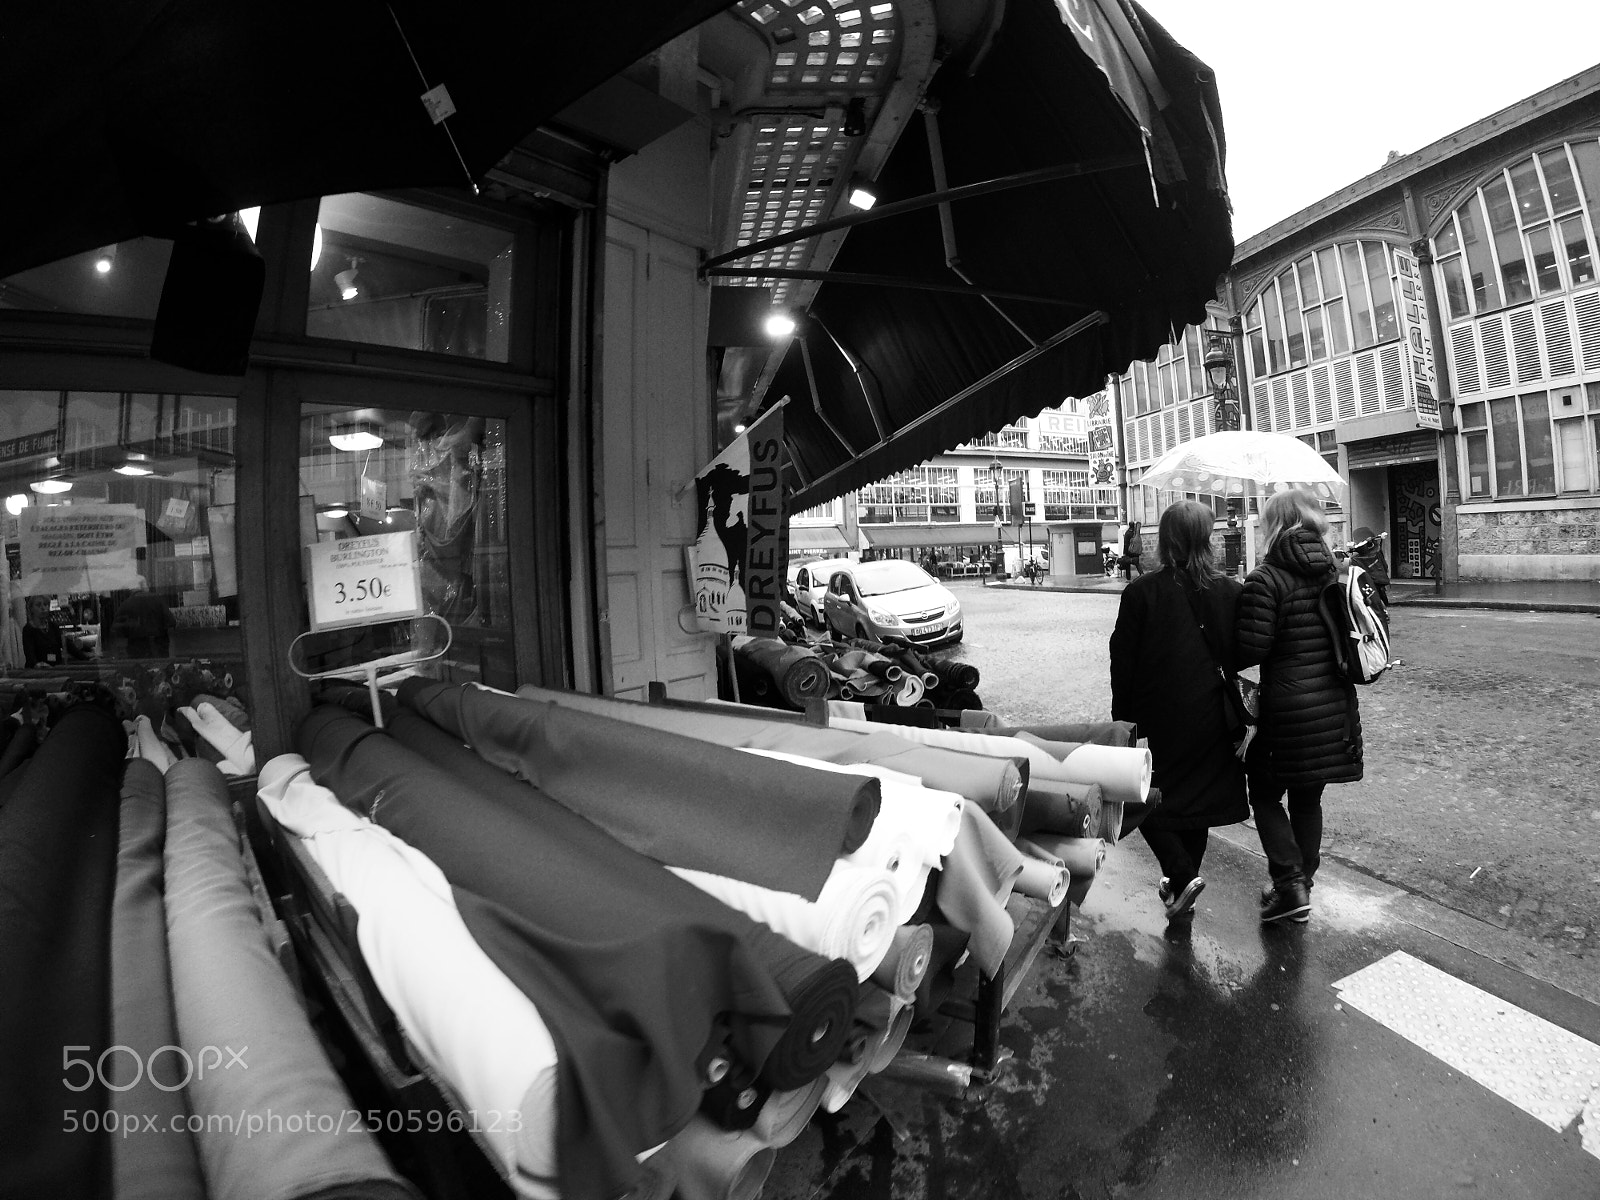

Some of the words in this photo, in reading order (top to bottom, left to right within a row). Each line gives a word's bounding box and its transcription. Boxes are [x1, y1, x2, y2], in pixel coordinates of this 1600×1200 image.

[1399, 255, 1428, 382] HALLE
[1411, 260, 1428, 320] PIERRE
[1423, 336, 1436, 383] SAINT
[750, 438, 780, 631] DREYFUS
[334, 577, 392, 604] 3.50€
